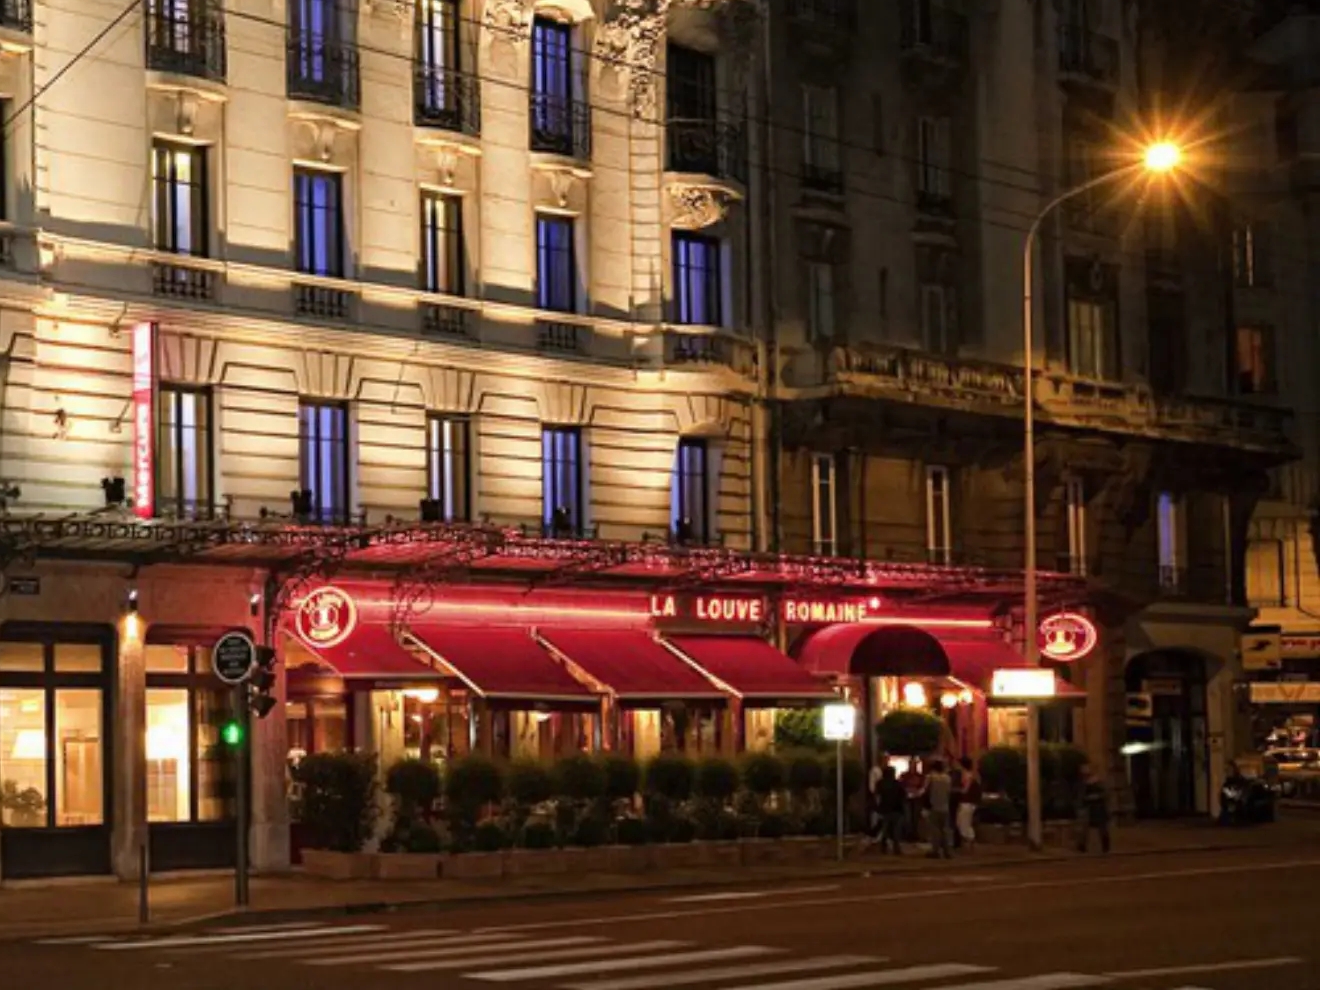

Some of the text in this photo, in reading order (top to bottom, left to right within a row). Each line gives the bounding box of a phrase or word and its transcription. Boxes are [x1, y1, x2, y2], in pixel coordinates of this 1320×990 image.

[651, 595, 867, 622] LA LOUVE ROMAINE
